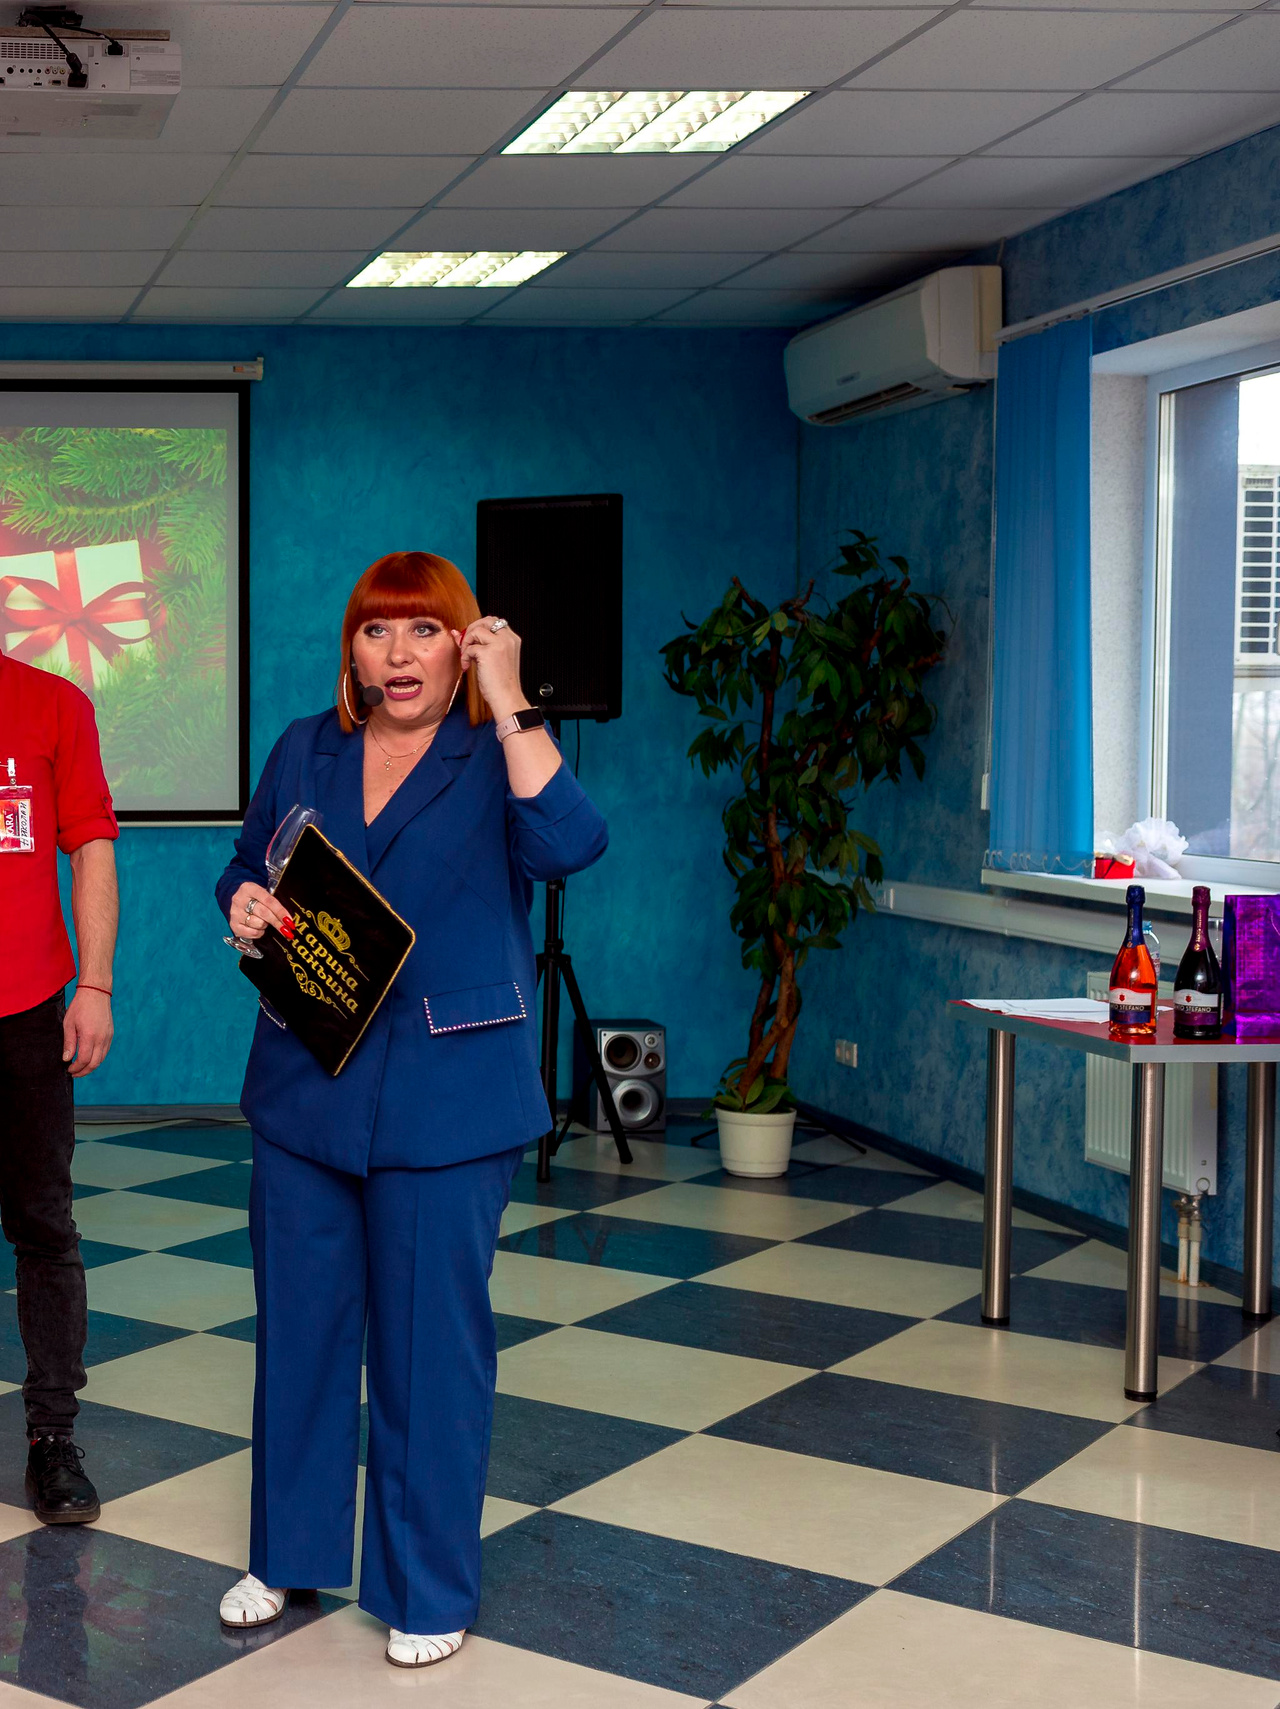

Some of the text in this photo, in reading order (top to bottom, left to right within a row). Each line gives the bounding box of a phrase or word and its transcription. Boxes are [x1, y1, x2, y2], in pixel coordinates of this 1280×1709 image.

[291, 912, 360, 993] Марина
[286, 936, 360, 1014] наньина
[1119, 1004, 1145, 1012] STEFANO
[1185, 1005, 1212, 1013] STEFANO
